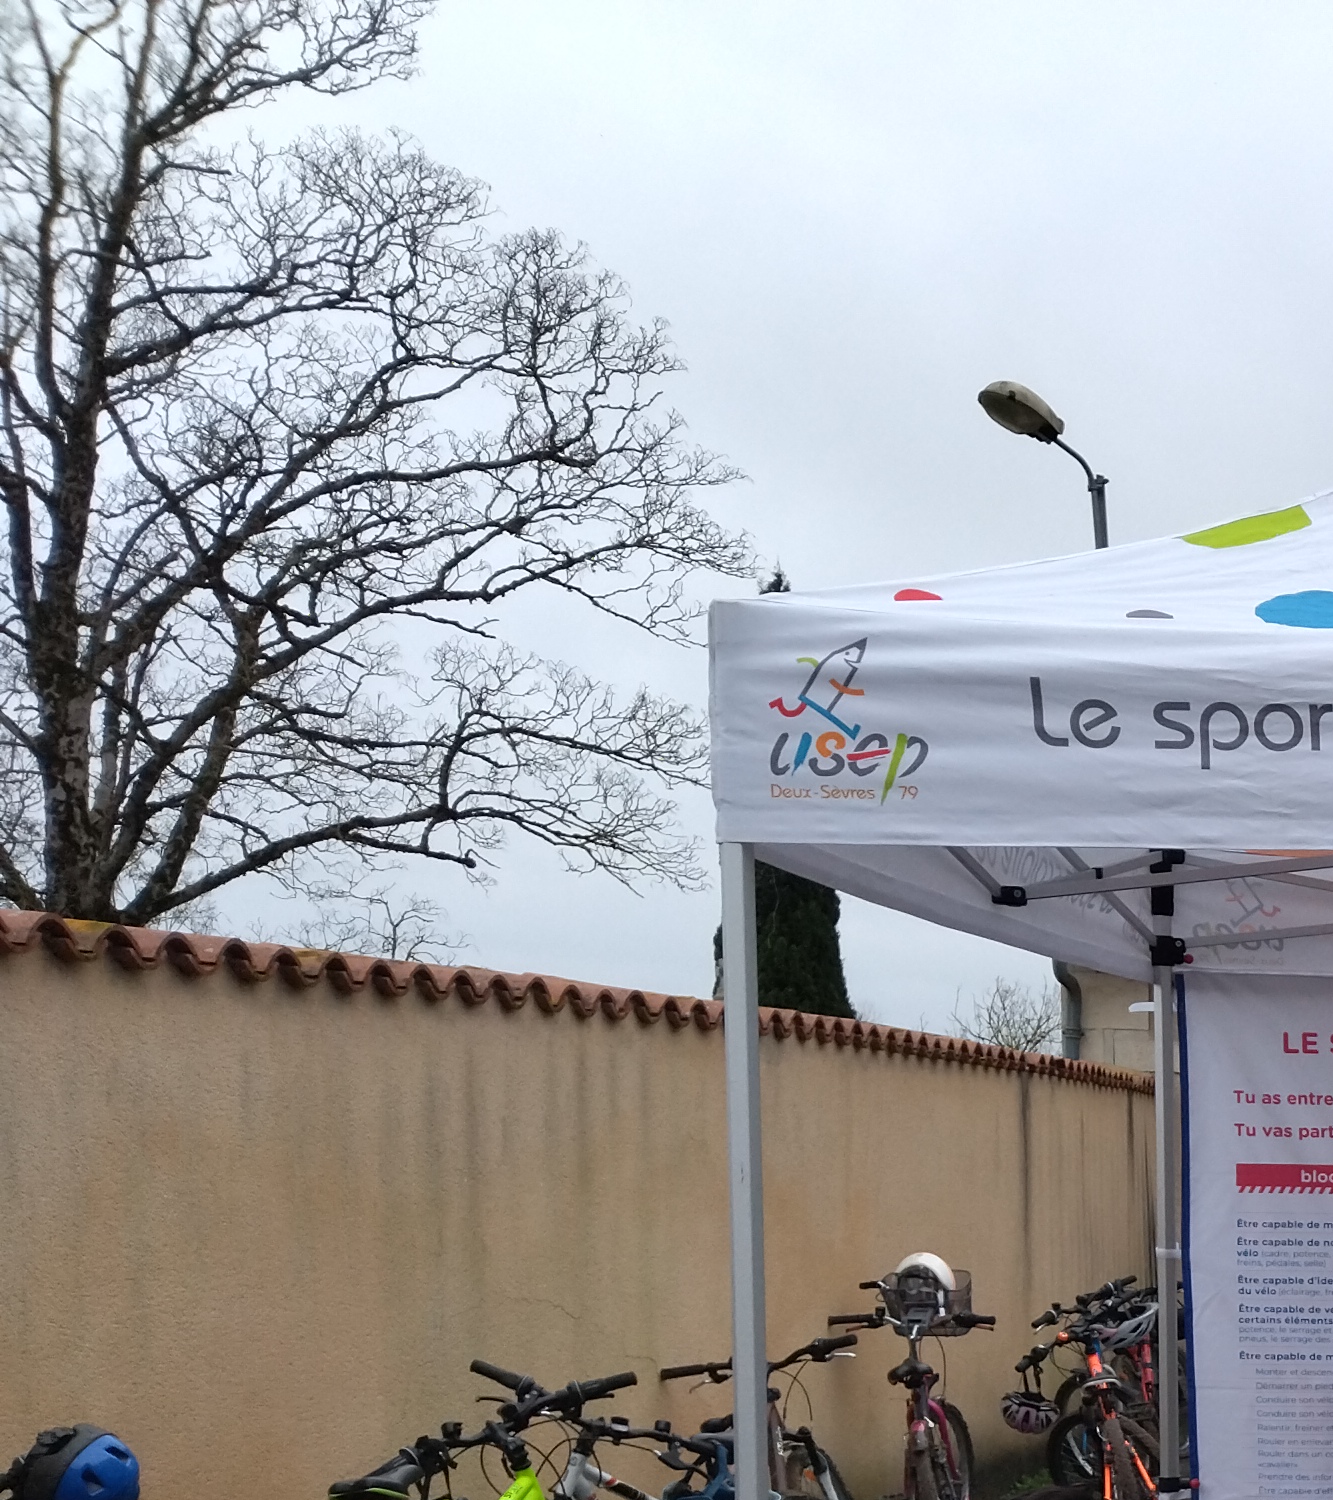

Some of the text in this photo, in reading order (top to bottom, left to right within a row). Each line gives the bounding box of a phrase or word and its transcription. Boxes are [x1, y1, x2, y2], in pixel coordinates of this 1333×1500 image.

[1030, 676, 1121, 749] Le
[770, 783, 919, 800] Deux-Sèvres 79
[1283, 1032, 1319, 1054] LE
[1233, 1090, 1255, 1103] Tu
[1262, 1094, 1281, 1104] as
[1287, 1092, 1333, 1105] entre
[1234, 1123, 1256, 1136] Tu
[1262, 1127, 1292, 1137] vas
[1237, 1217, 1258, 1228] Être
[1262, 1220, 1303, 1230] capable
[1307, 1220, 1320, 1229] de
